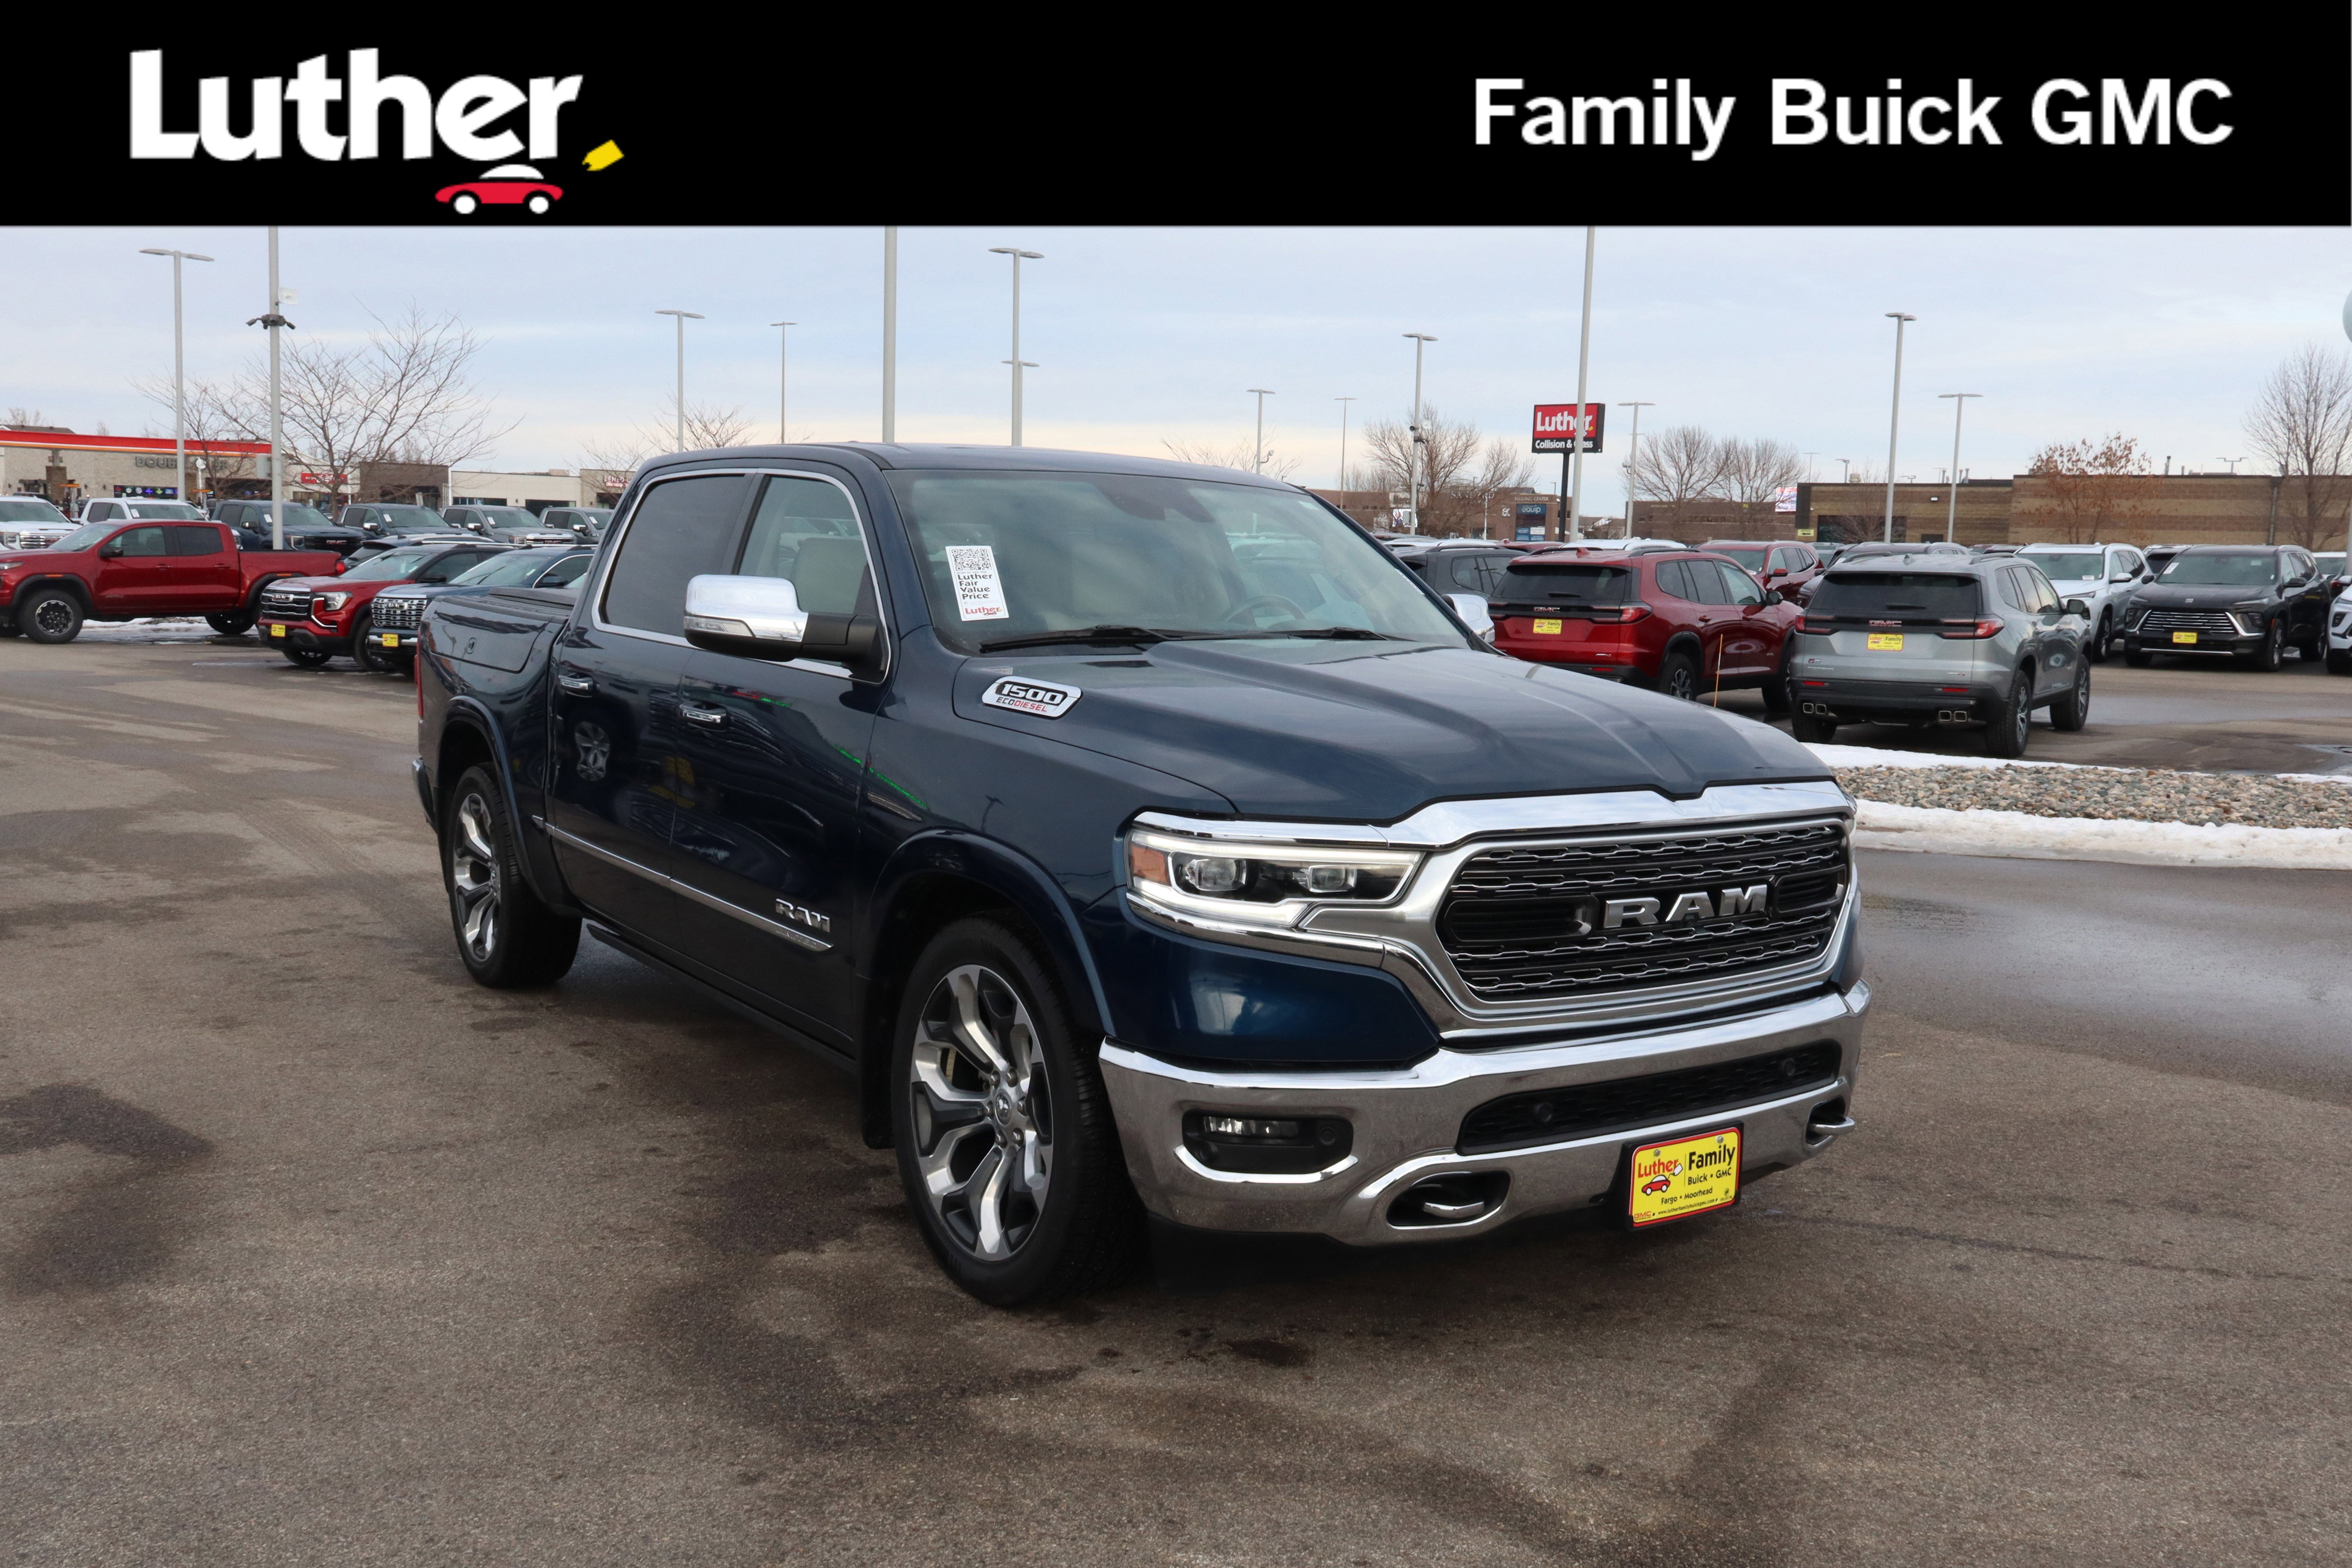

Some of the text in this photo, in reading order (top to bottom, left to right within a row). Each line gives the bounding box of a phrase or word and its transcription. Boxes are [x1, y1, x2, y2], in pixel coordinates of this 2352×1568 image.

[1537, 411, 1593, 431] Luthr
[1535, 439, 1565, 448] Collision
[1566, 439, 1572, 448] &
[1522, 505, 1541, 514] equip
[1002, 684, 1065, 704] 1500
[996, 697, 1048, 712] ECODIESEL
[776, 898, 830, 933] RAM
[1604, 884, 1768, 928] RAM
[1638, 1144, 1735, 1178] Luther Family
[1688, 1167, 1731, 1185] Buick GMC
[1684, 1186, 1713, 1200] Moorhead
